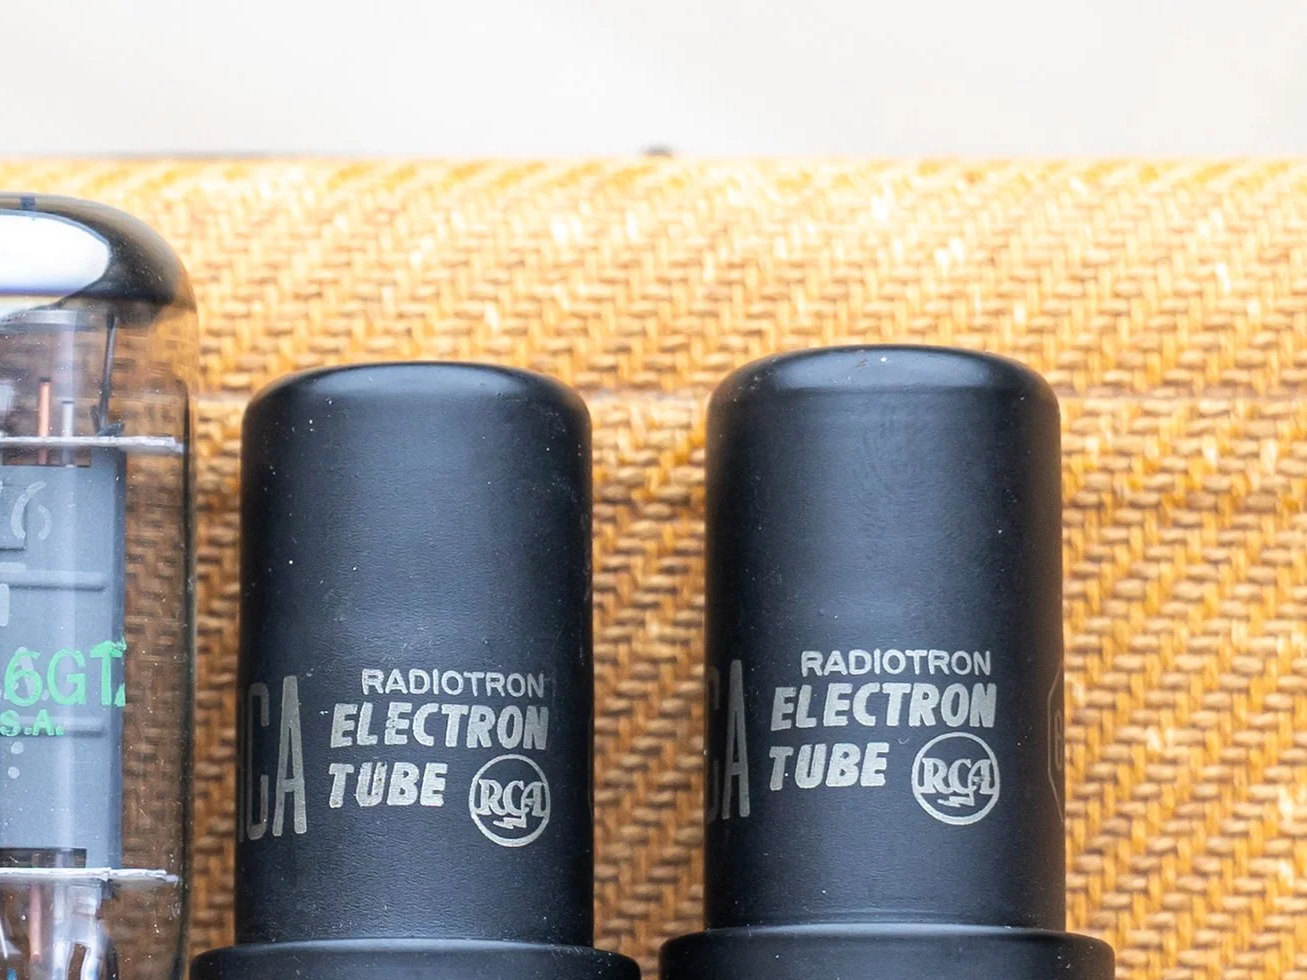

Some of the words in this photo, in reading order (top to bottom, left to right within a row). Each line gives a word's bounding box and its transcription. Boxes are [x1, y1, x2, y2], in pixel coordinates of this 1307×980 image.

[361, 668, 544, 698] RADIOTRON
[801, 648, 991, 677] RADIOTRON
[330, 702, 549, 750] ELECTRON
[770, 681, 997, 731] ELECTRON
[240, 675, 308, 842] CA
[769, 742, 890, 791] TUBE
[328, 761, 448, 809] TUBE
